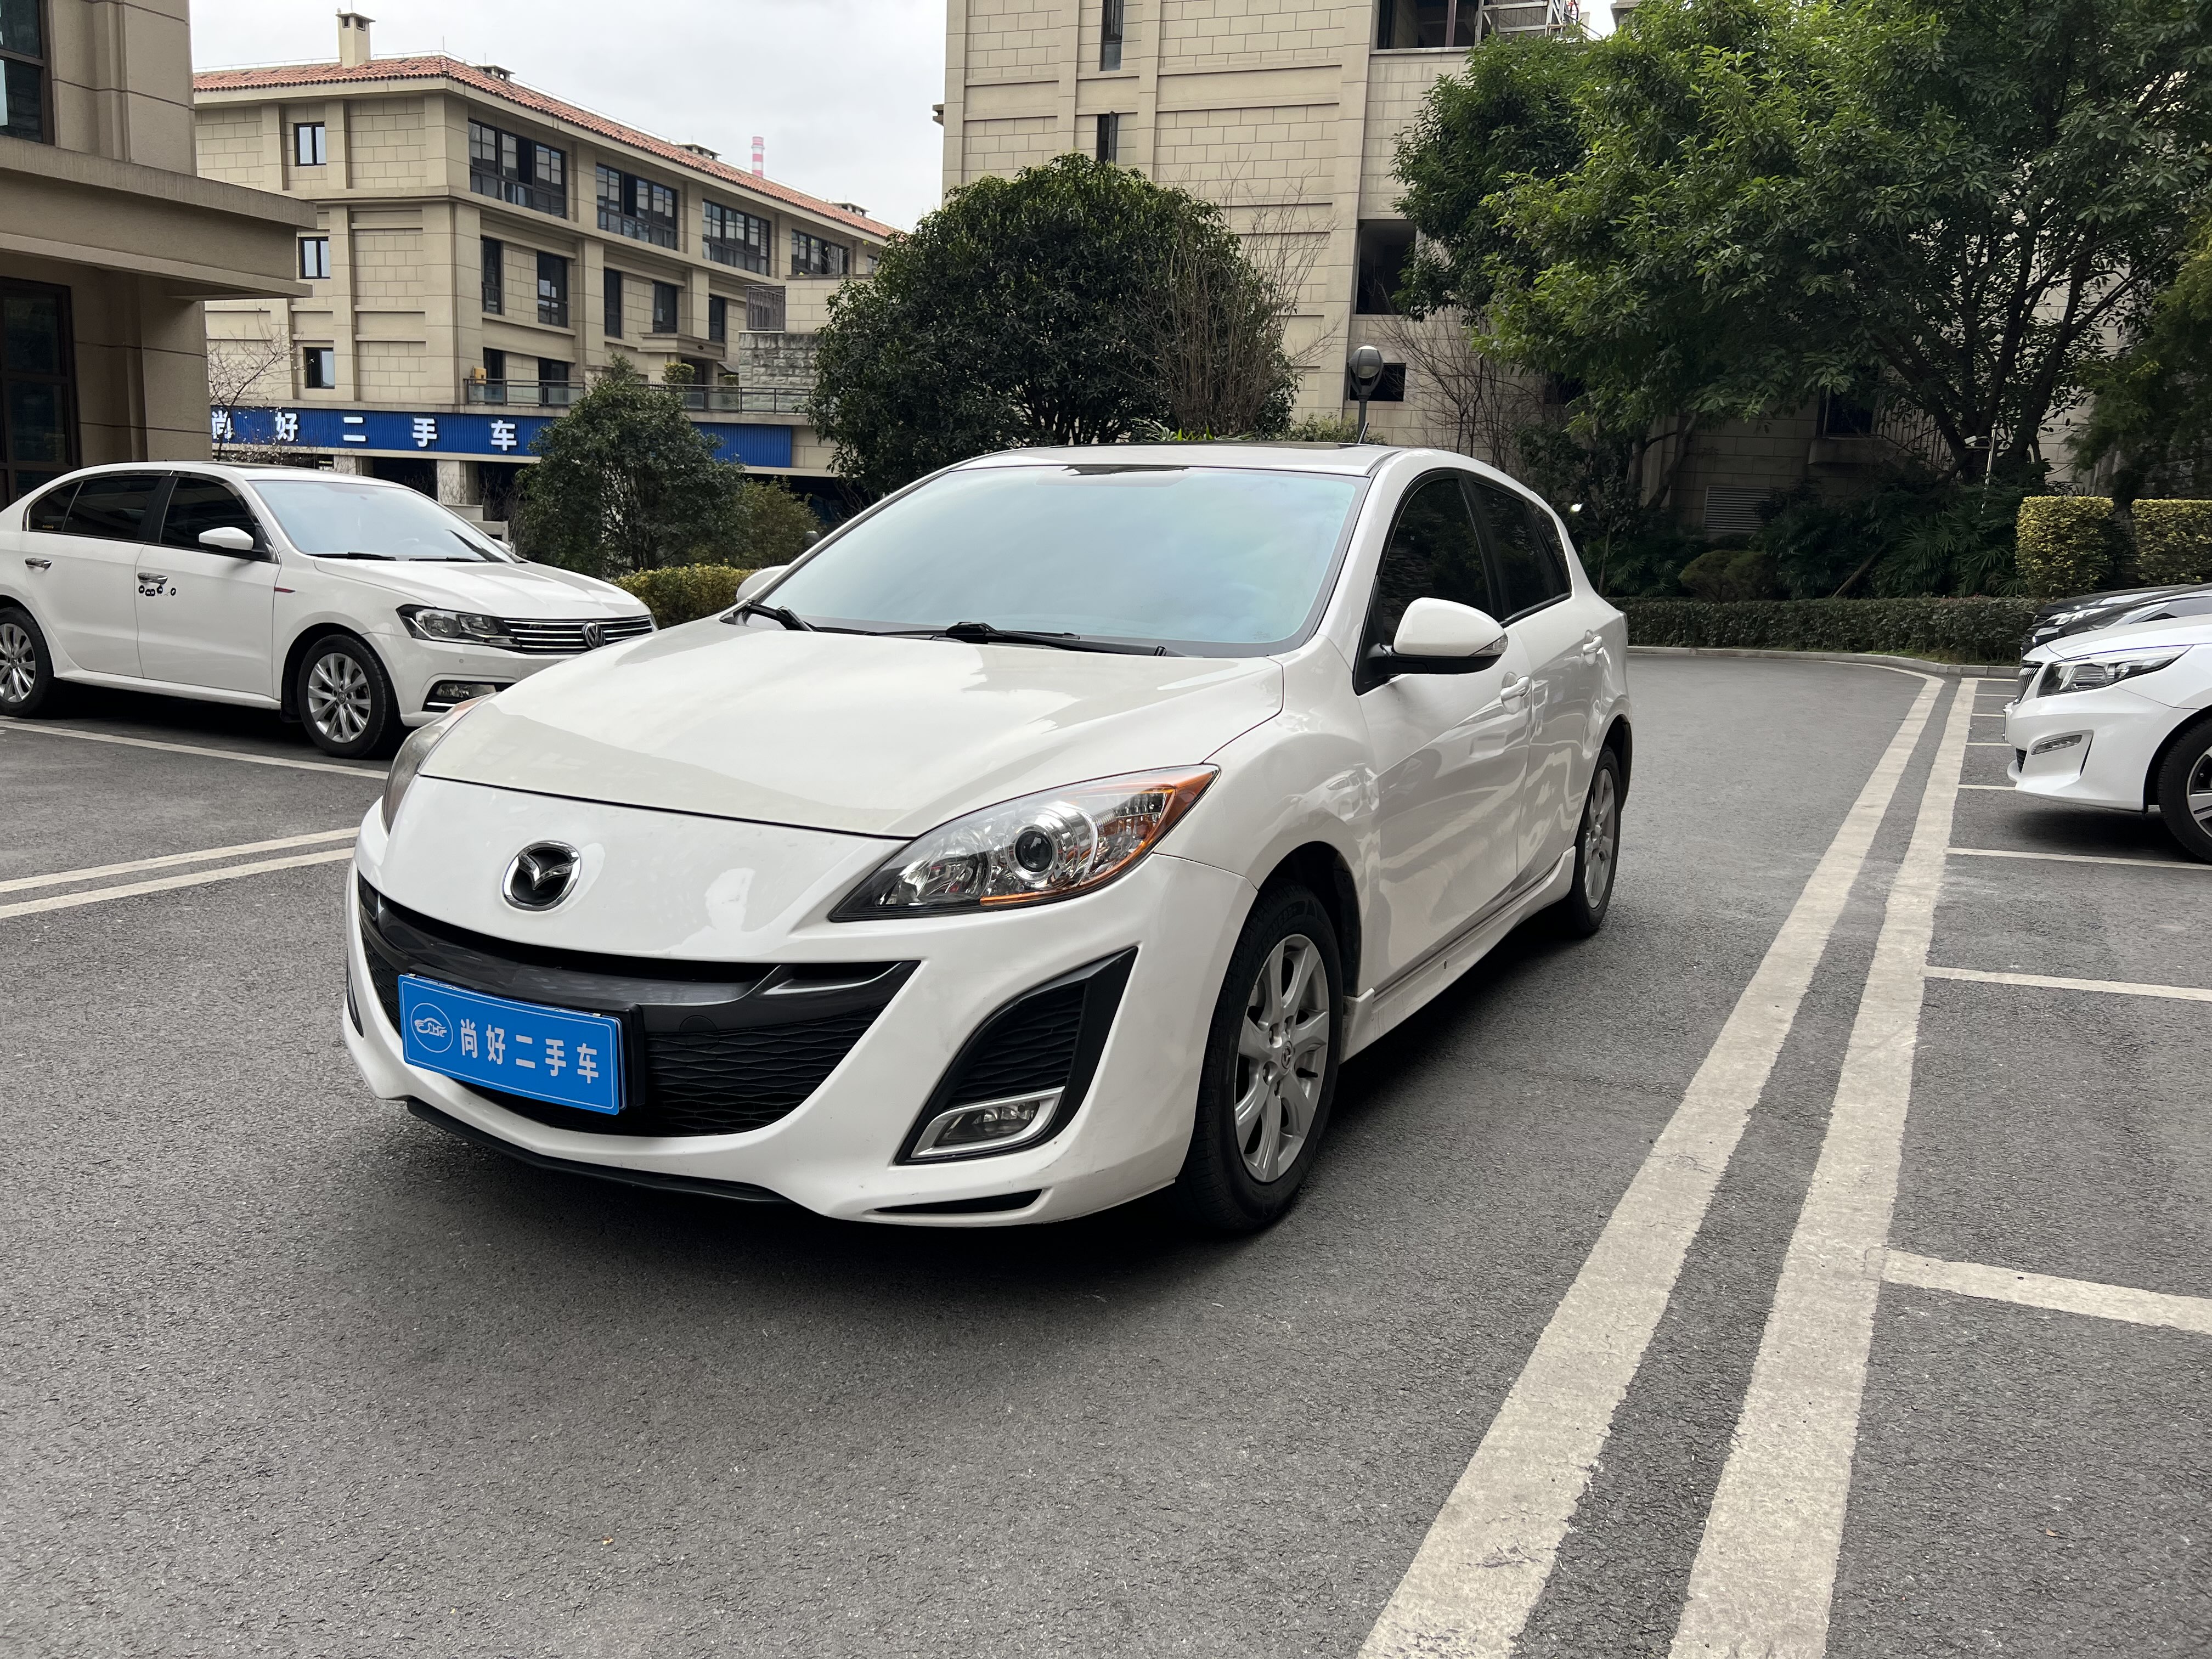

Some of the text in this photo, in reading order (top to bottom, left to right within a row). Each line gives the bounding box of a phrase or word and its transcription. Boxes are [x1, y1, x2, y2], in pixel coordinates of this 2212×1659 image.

[211, 410, 517, 451] 尚好二手车
[460, 1018, 599, 1084] 尚好二手车
